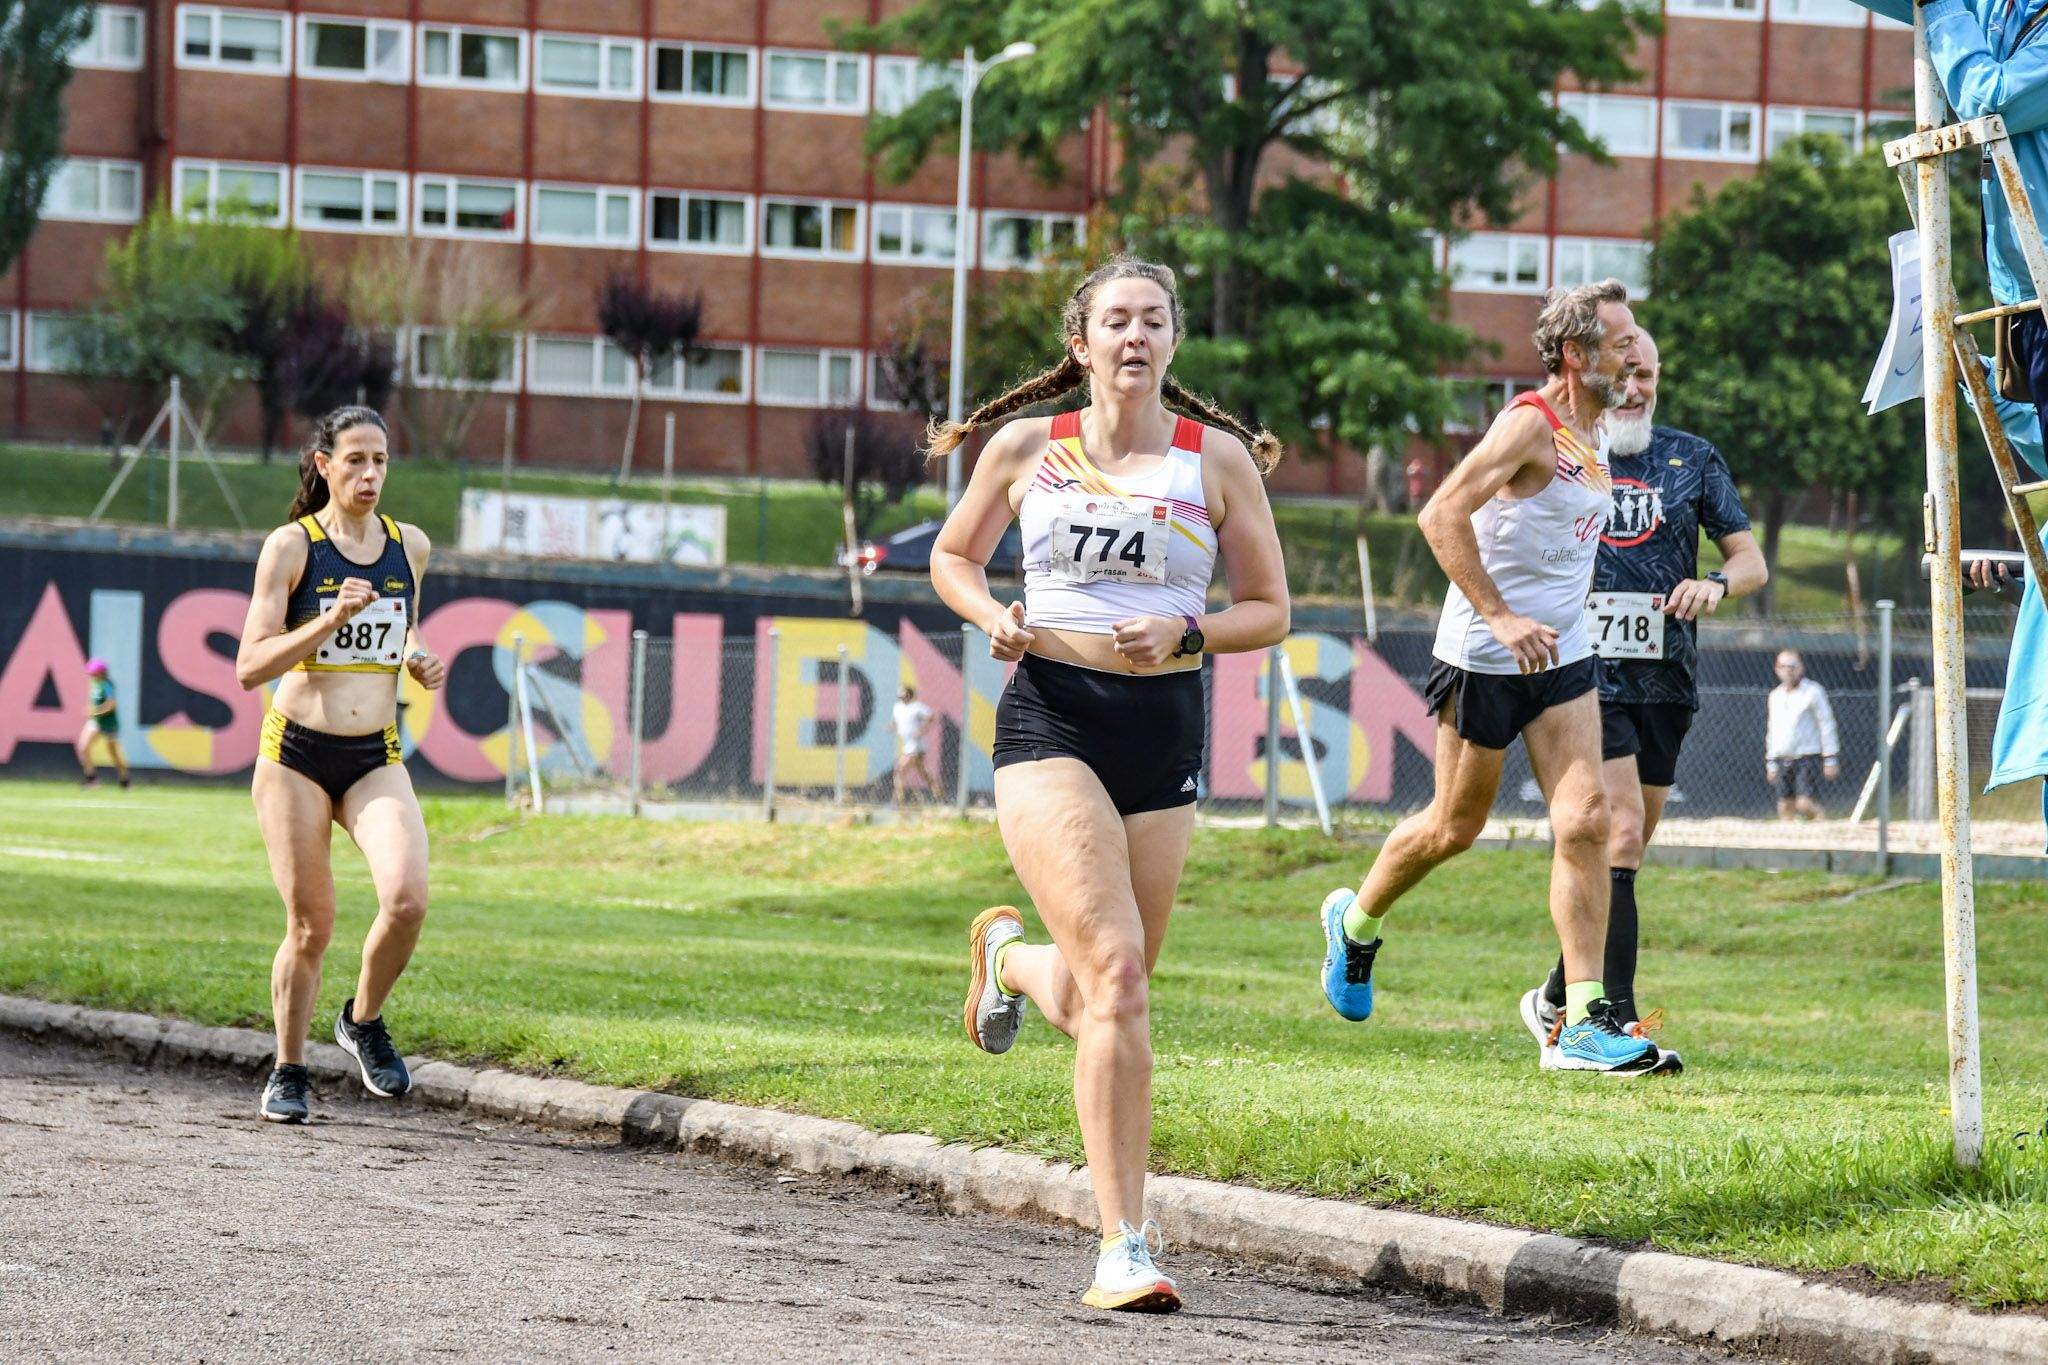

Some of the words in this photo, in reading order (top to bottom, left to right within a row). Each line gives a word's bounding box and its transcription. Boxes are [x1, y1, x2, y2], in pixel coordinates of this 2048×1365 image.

[1069, 524, 1146, 569] 774
[334, 622, 392, 650] 887
[1597, 615, 1650, 642] 718
